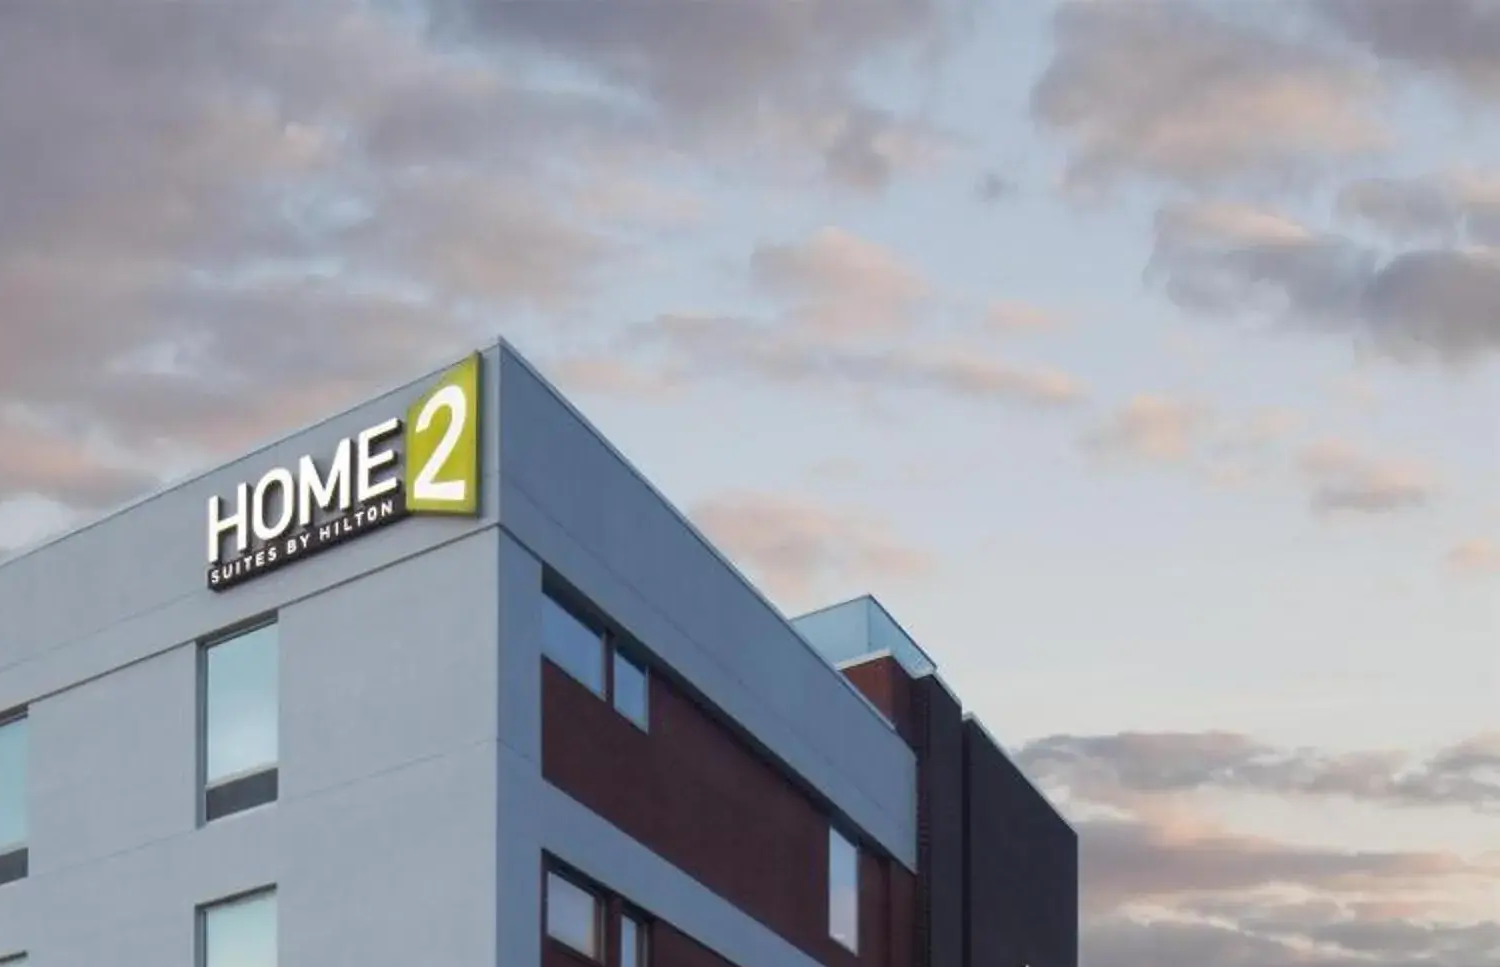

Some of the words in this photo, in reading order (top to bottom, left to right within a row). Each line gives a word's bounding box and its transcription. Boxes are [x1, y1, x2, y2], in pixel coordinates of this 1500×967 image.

[209, 418, 398, 563] HOME
[414, 385, 466, 500] 2
[211, 547, 277, 584] SUITES
[287, 533, 311, 554] BY
[319, 501, 394, 540] HILTON
